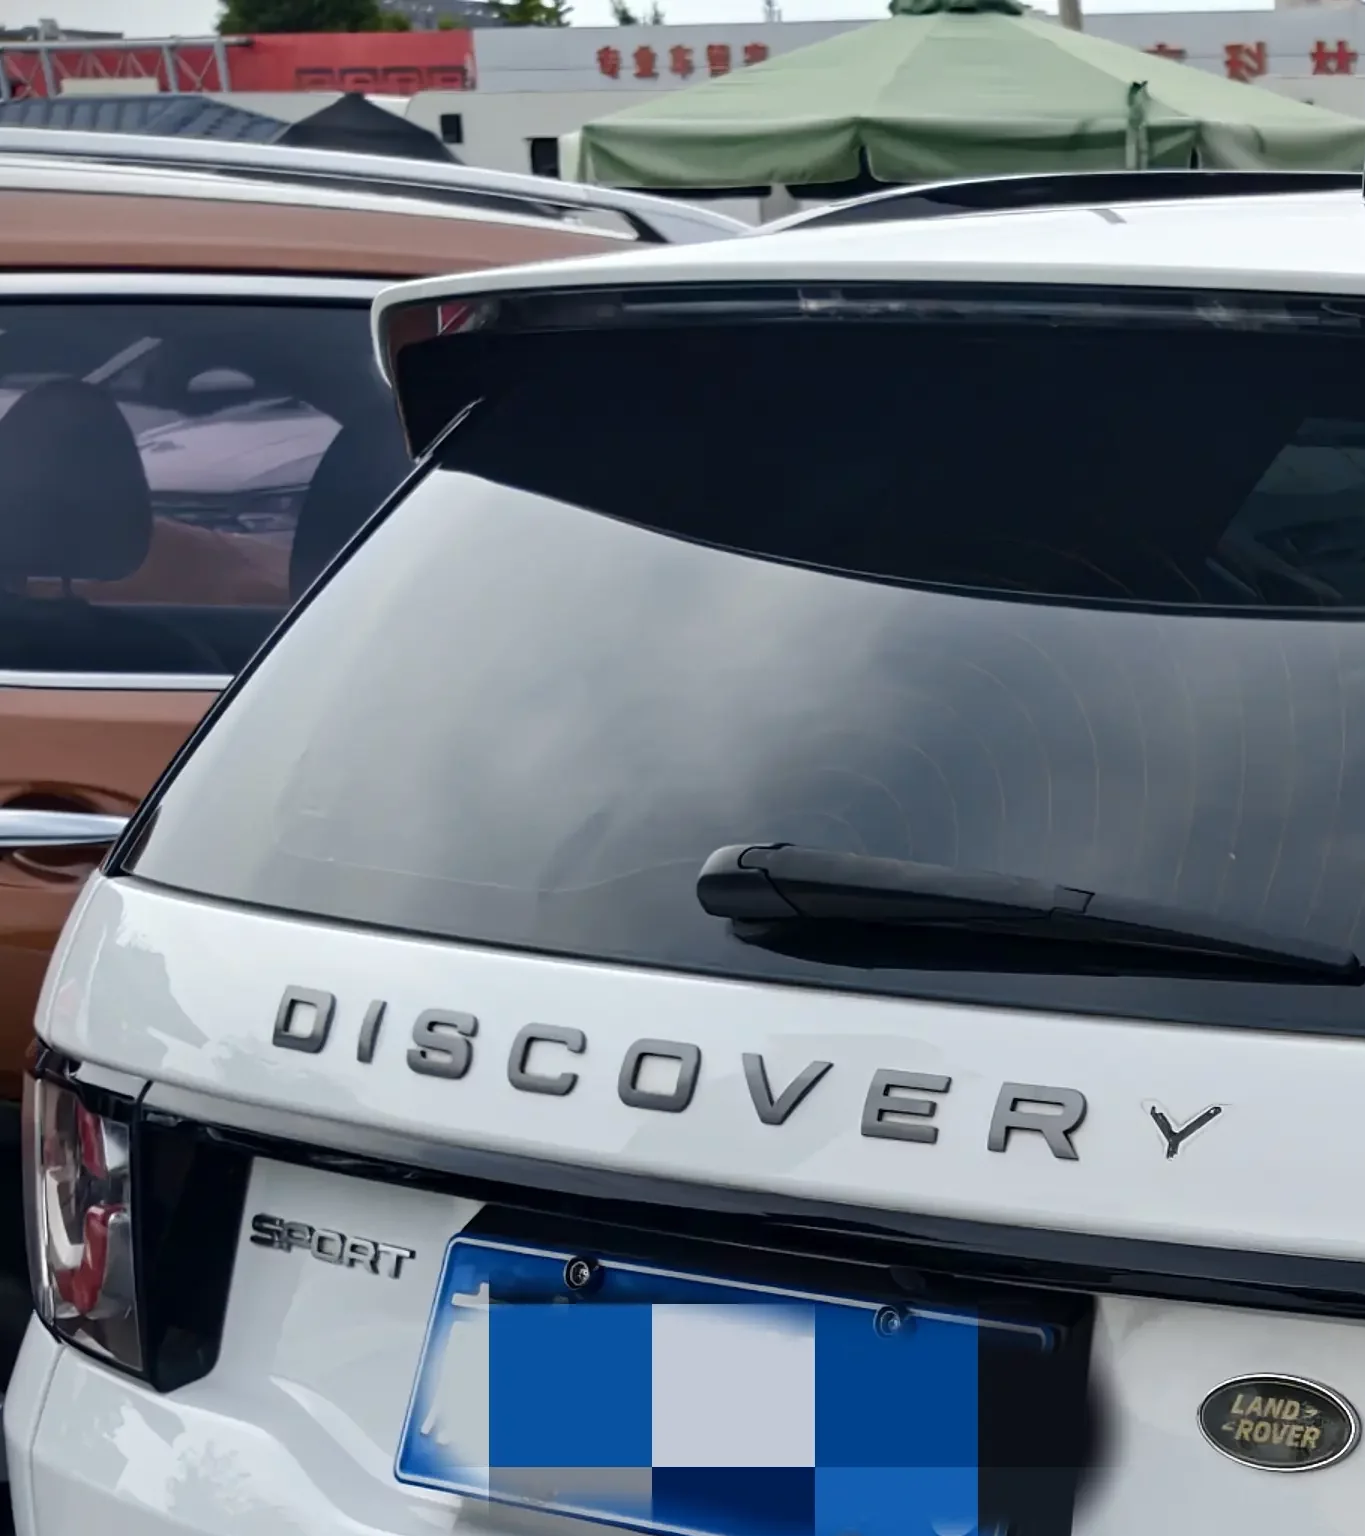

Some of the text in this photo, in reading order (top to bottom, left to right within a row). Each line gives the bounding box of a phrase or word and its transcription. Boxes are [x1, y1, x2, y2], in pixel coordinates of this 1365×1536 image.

[272, 984, 1224, 1162] DISCOVERY
[250, 1212, 416, 1280] SPORT
[1230, 1393, 1300, 1420] LAND
[1234, 1418, 1321, 1449] ROVER
